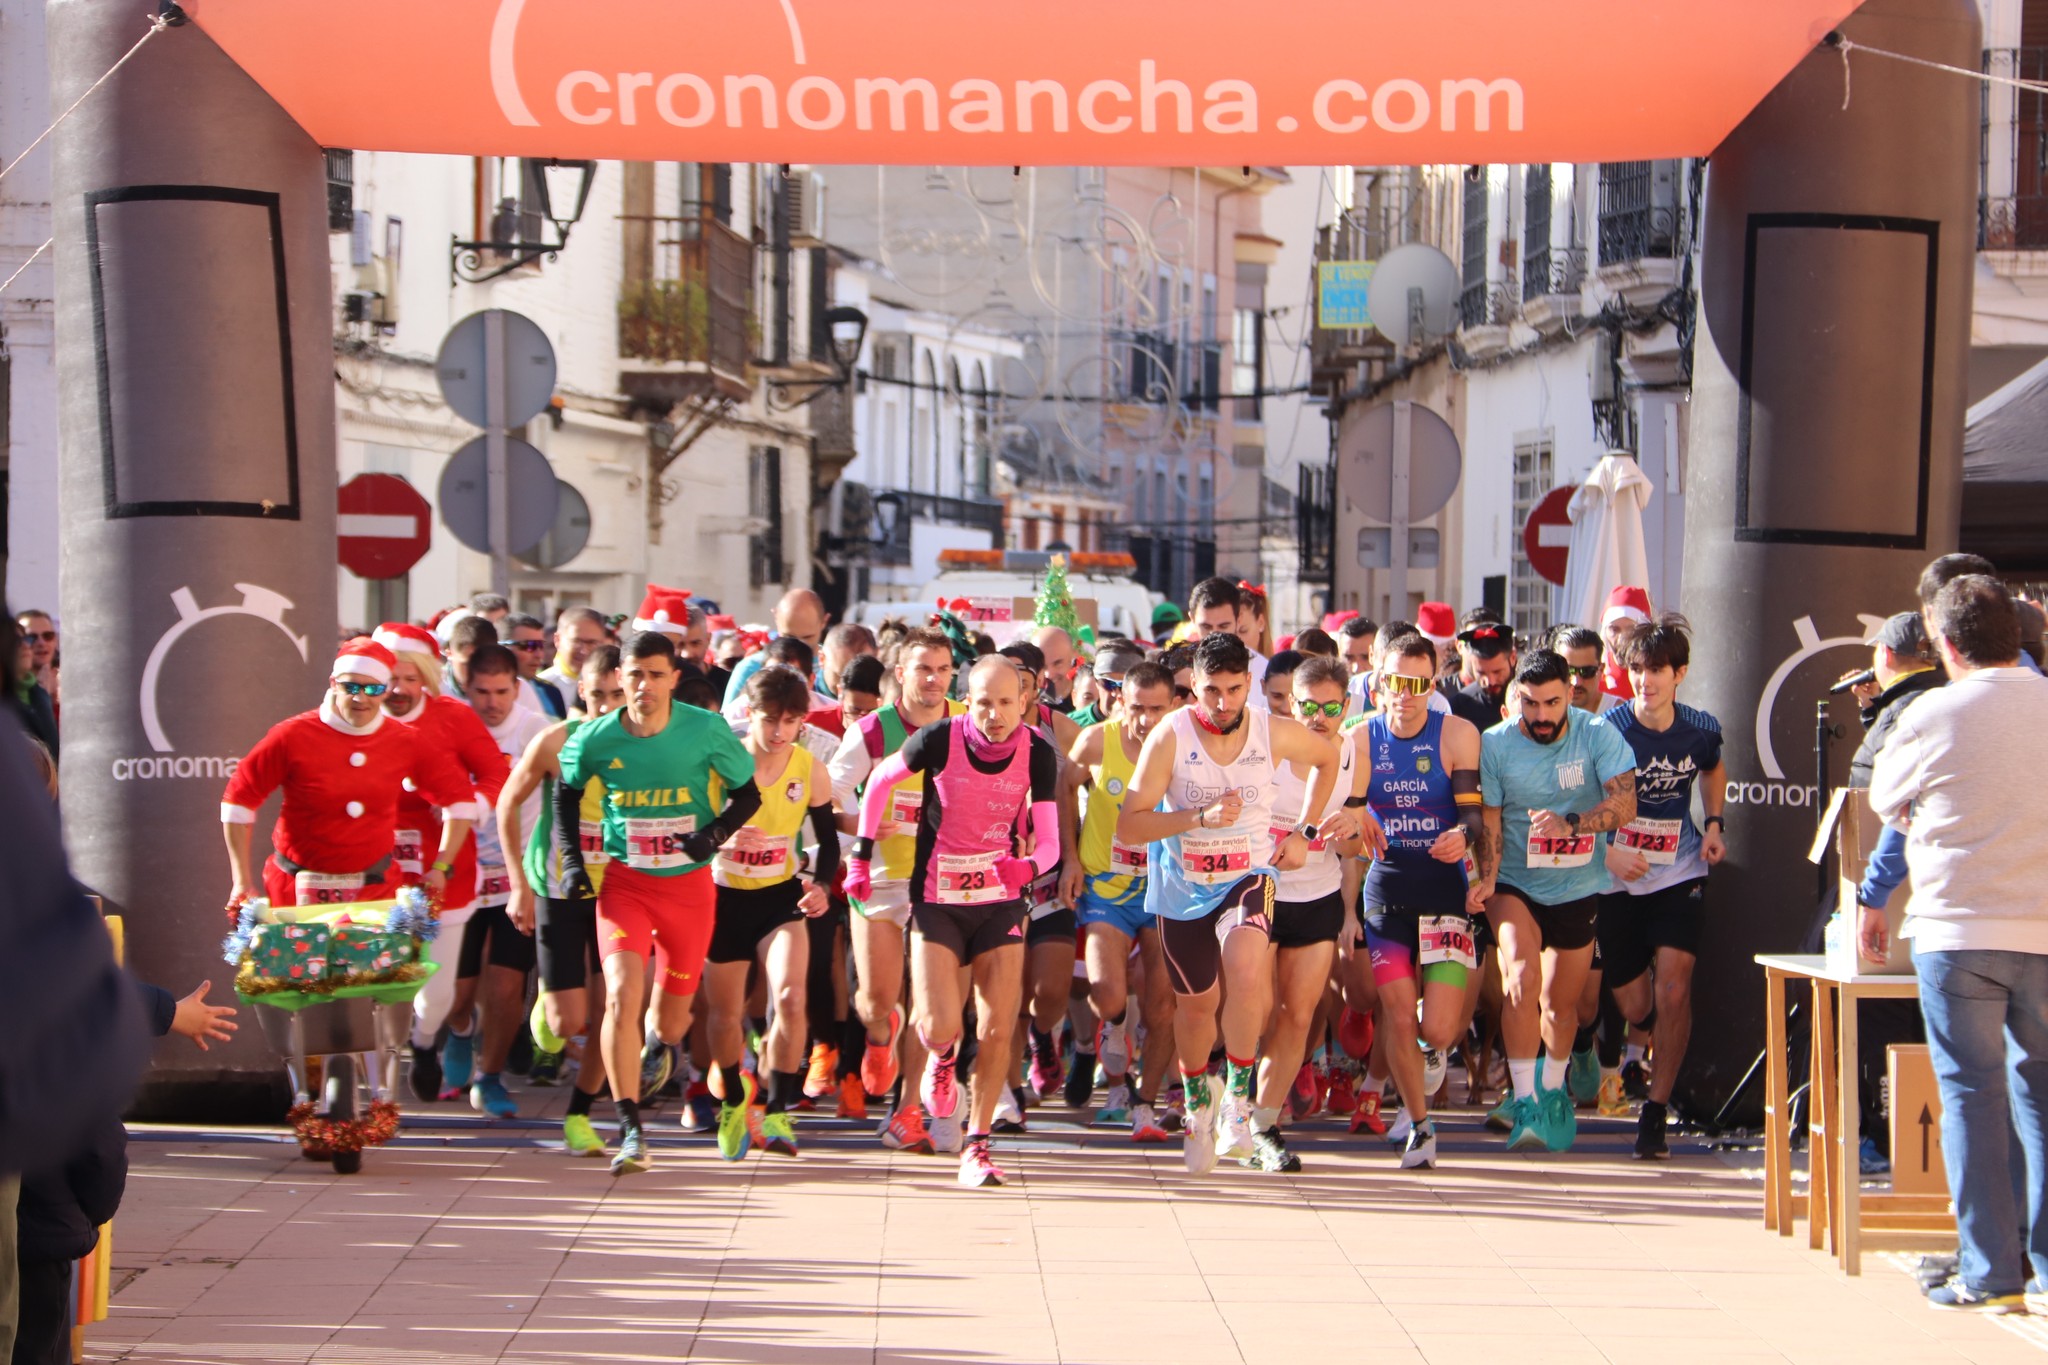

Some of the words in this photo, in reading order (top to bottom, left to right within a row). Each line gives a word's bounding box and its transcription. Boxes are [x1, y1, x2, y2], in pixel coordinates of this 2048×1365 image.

[556, 59, 1524, 133] cronomancha.com
[976, 608, 994, 621] 71
[1383, 778, 1428, 792] GARCÍA
[1395, 796, 1419, 808] ESP
[649, 837, 674, 855] 19
[1544, 839, 1581, 855] 127
[1630, 832, 1666, 851] 123
[739, 850, 773, 866] 106
[1202, 854, 1229, 873] 34
[959, 871, 985, 890] 23
[317, 889, 342, 903] 93
[1440, 931, 1463, 950] 40
